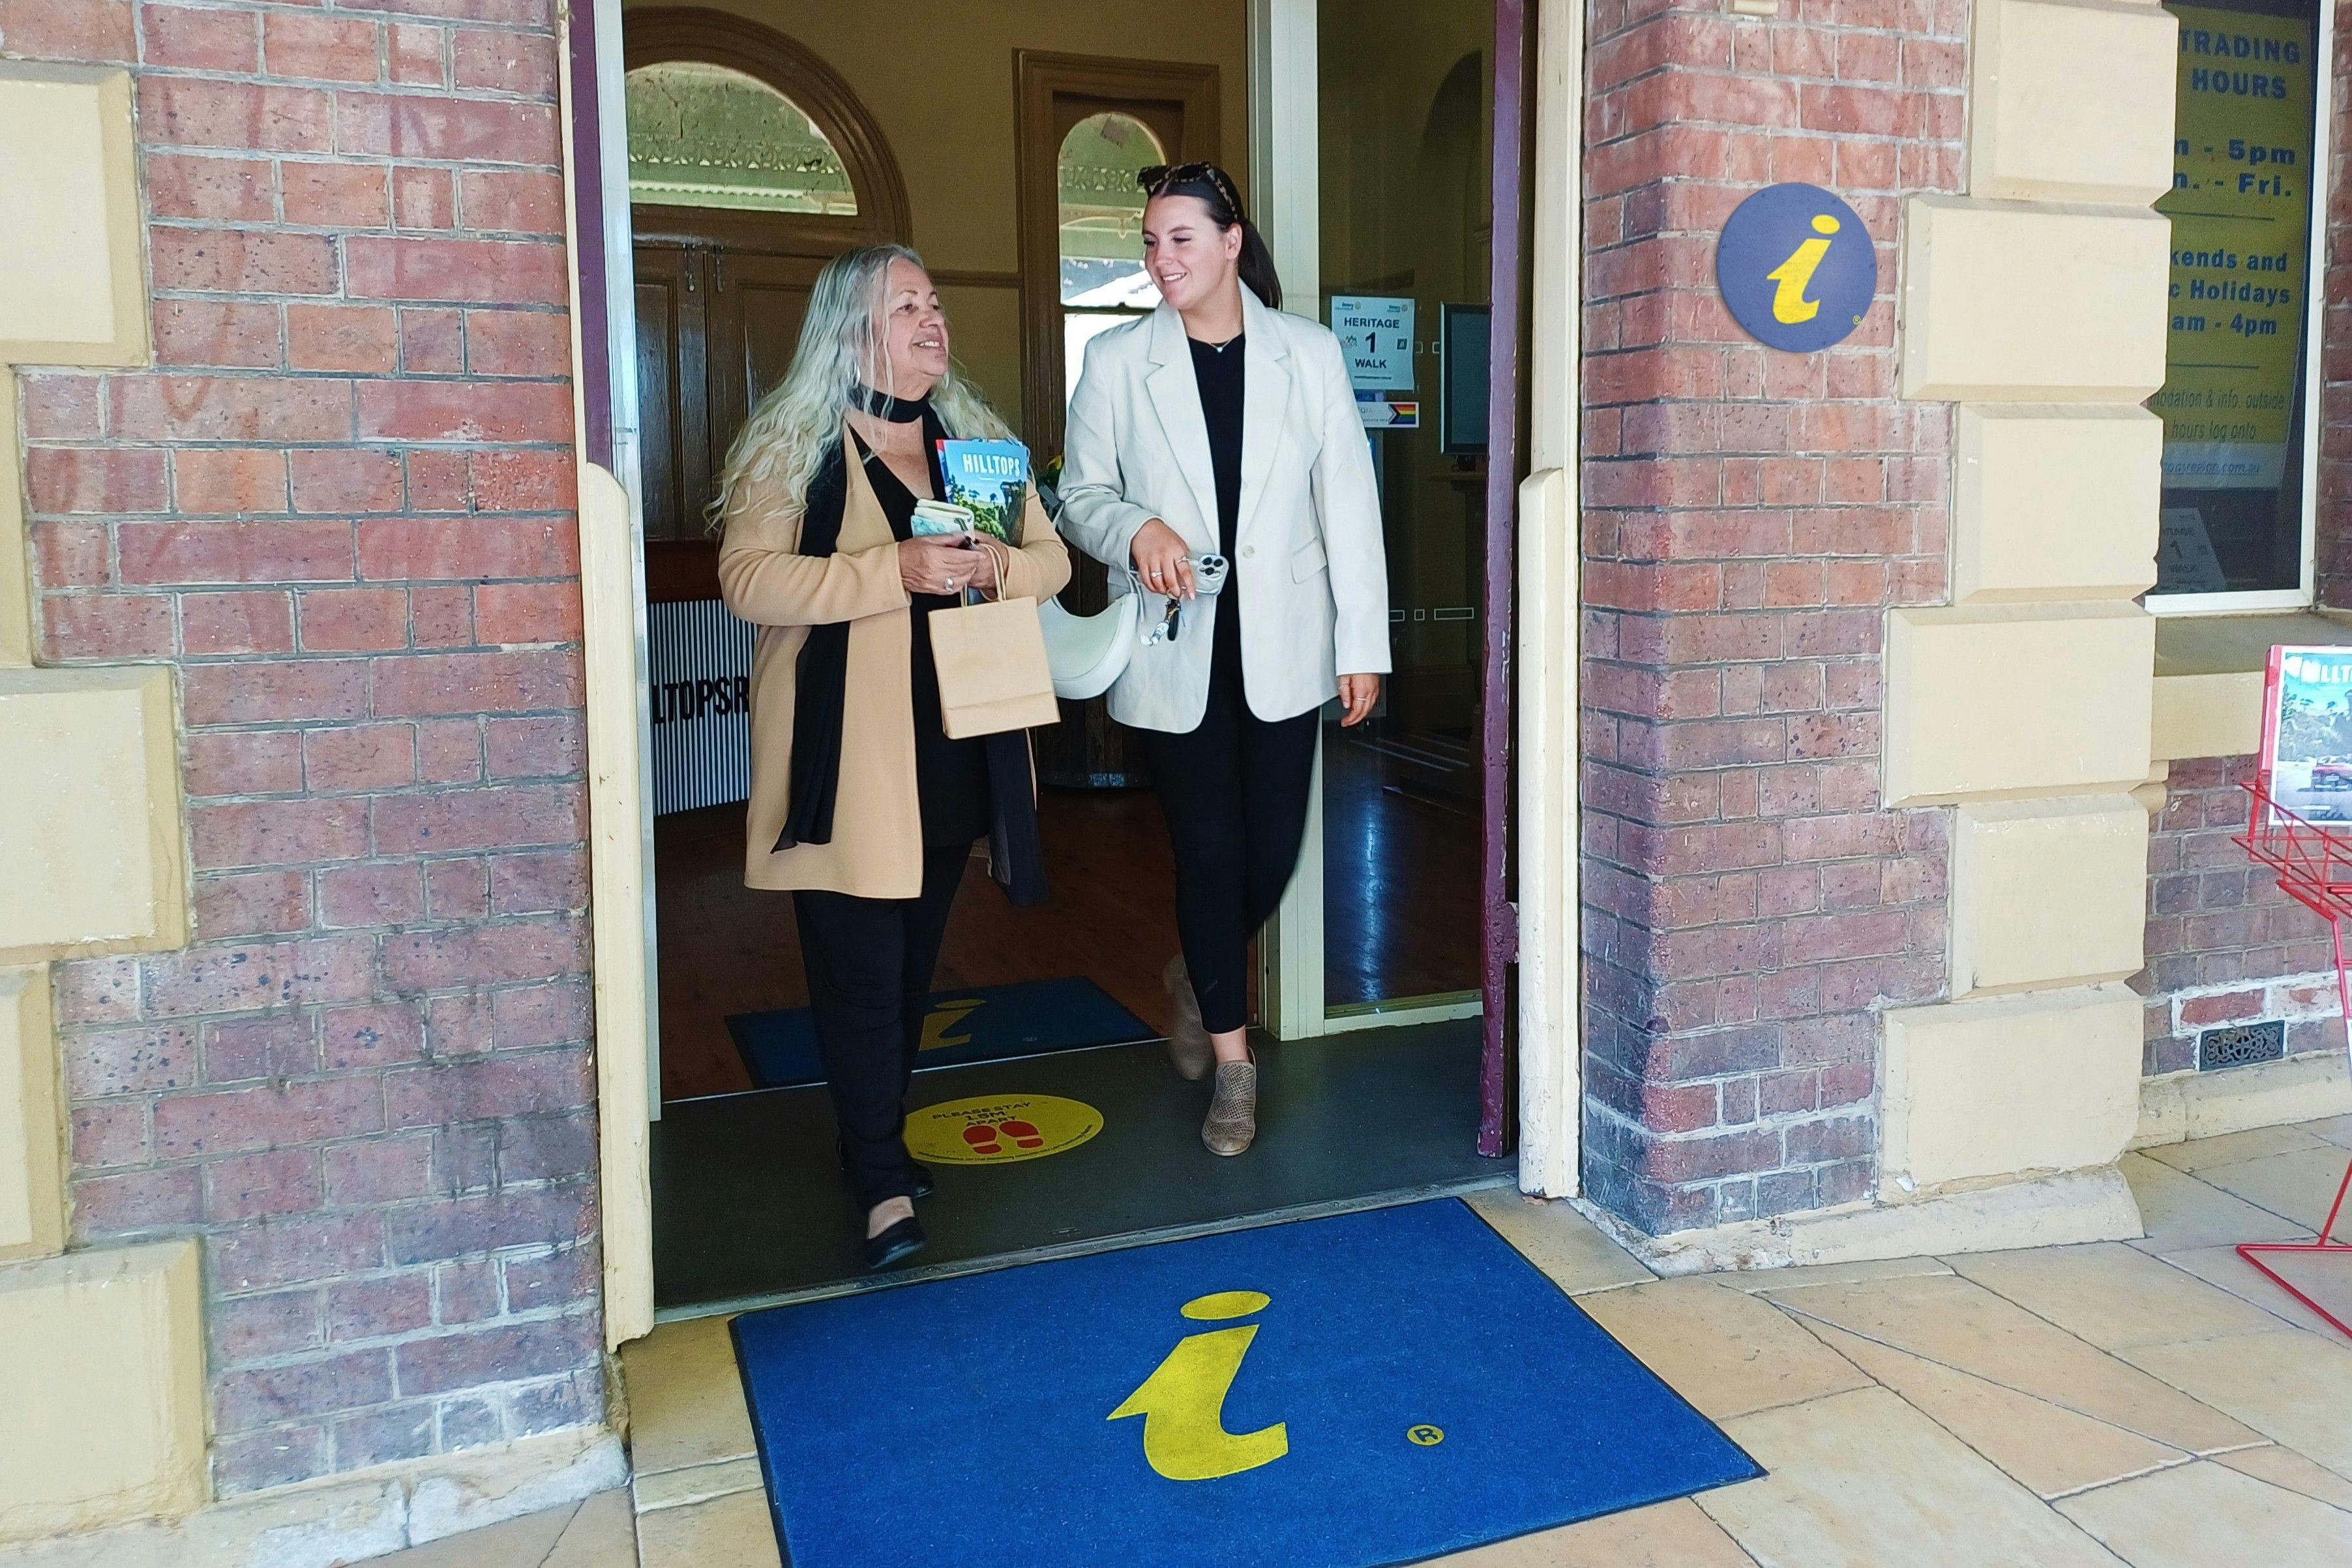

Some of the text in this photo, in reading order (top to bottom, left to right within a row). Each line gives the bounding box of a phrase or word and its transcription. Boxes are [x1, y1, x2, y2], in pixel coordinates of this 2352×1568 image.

[2181, 29, 2300, 64] TRADING
[2192, 68, 2287, 99] HOURS
[2227, 139, 2295, 166] 5pm
[2238, 172, 2291, 197] Fri.
[2246, 252, 2287, 272] and
[2190, 278, 2291, 308] Holidays
[1344, 317, 1400, 329] HERITAGE
[2229, 312, 2277, 338] 4pm
[1365, 331, 1376, 353] 1
[1354, 358, 1387, 368] WALK
[2245, 390, 2284, 410] outside
[2172, 420, 2204, 439] hours
[962, 453, 1020, 477] HILLTOPS
[932, 1101, 1031, 1119] PLEASE STAY
[966, 1116, 1016, 1127] APART
